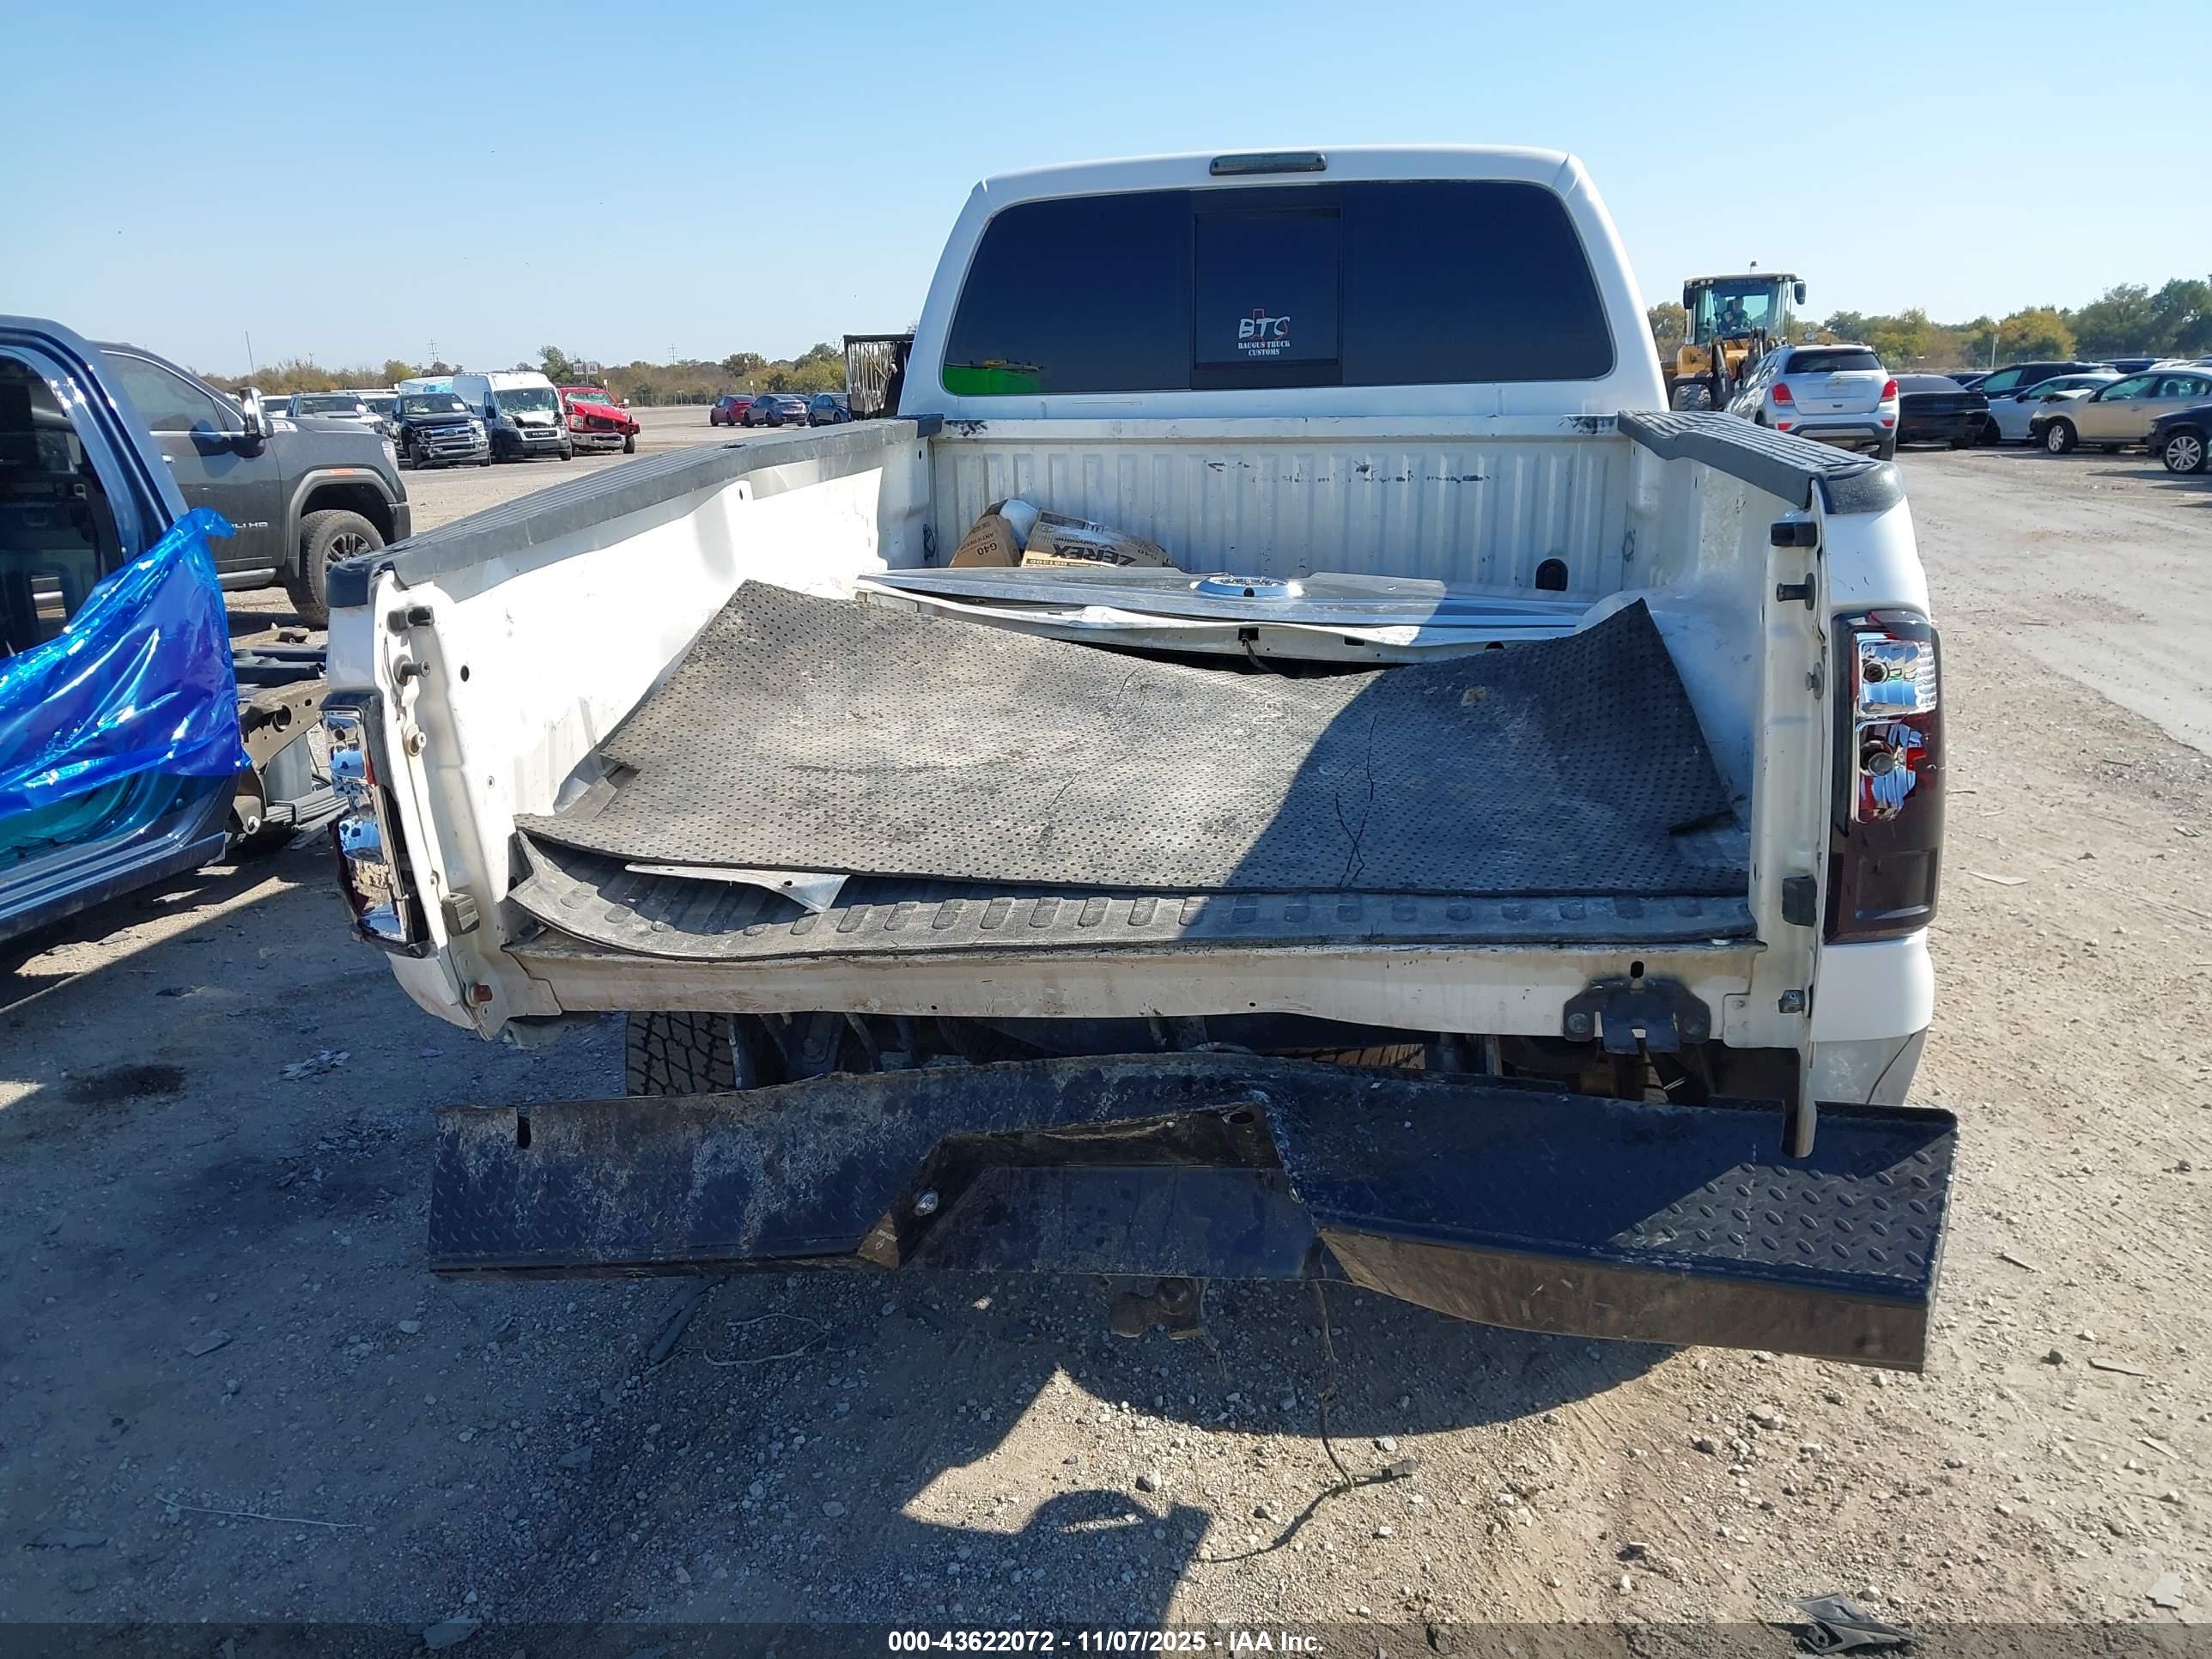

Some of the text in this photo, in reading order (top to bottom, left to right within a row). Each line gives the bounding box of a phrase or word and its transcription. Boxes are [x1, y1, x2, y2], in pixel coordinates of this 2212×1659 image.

[1238, 316, 1291, 339] BTC
[976, 542, 998, 556] G40
[1049, 544, 1138, 566] ZEREX
